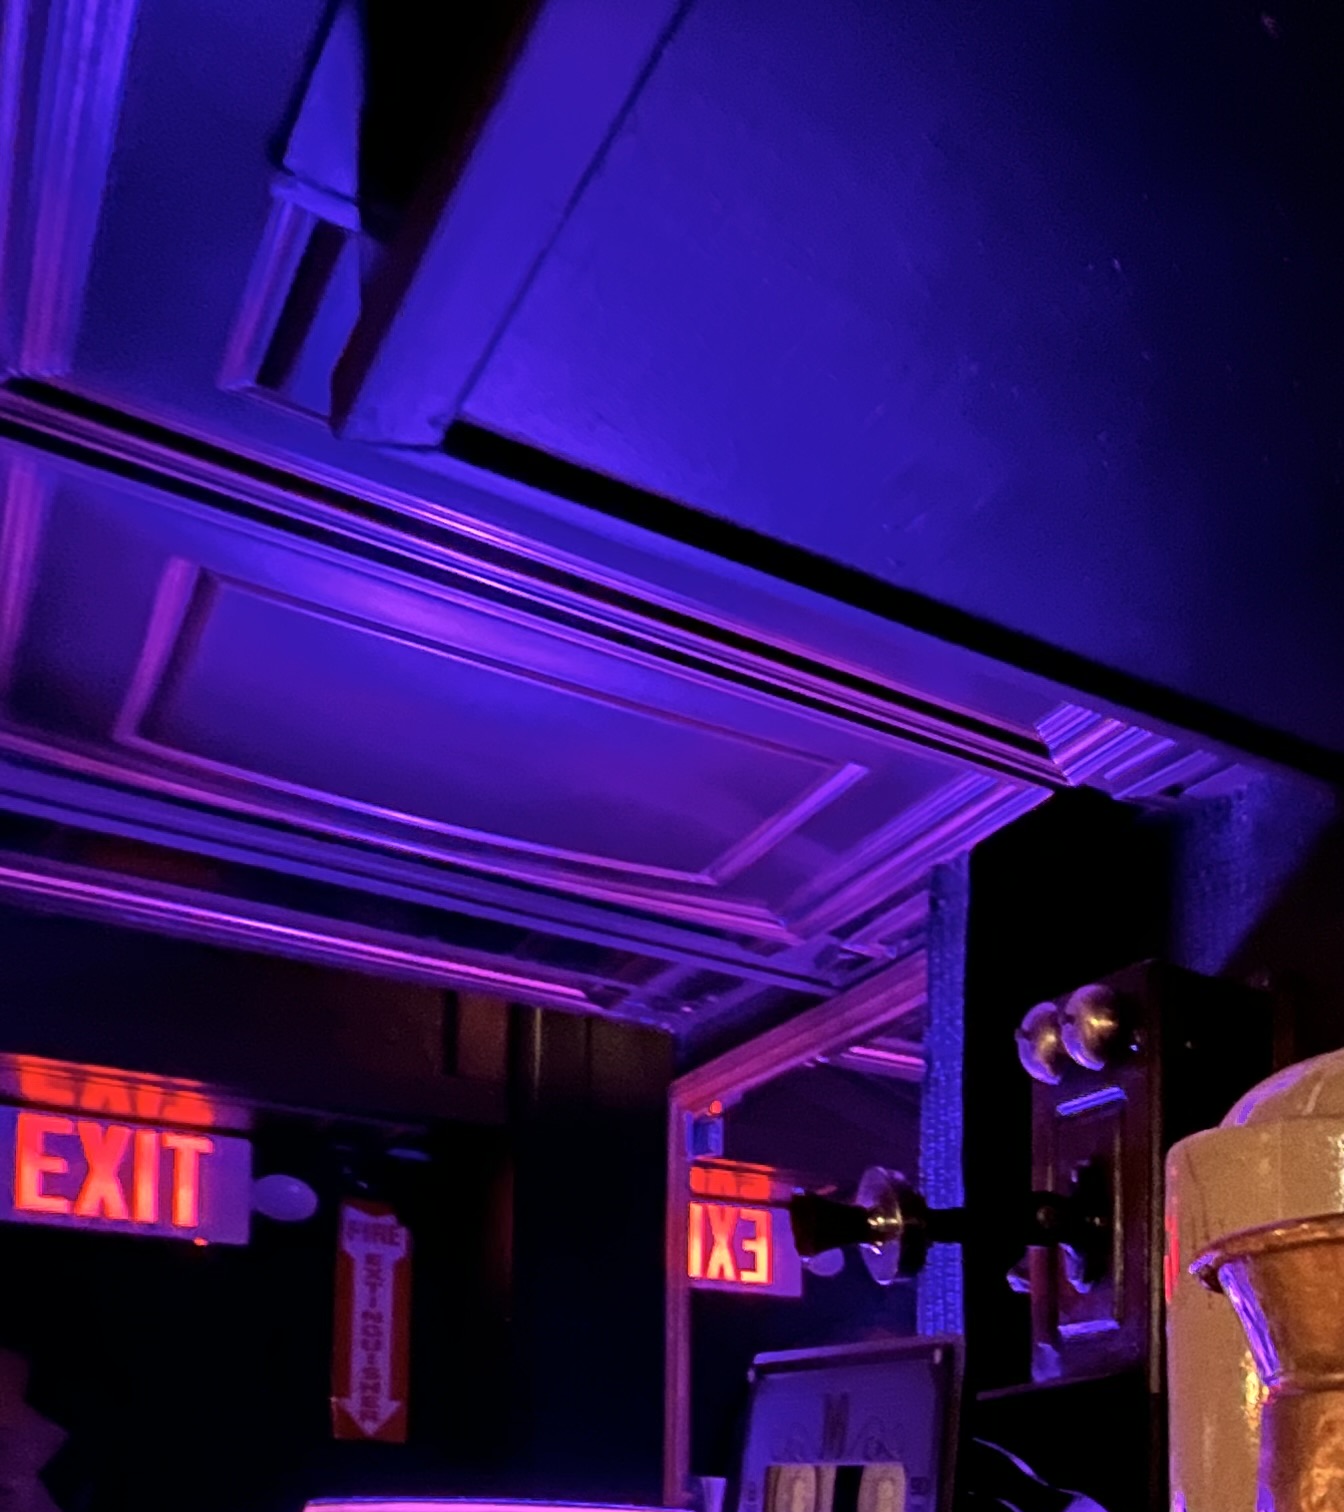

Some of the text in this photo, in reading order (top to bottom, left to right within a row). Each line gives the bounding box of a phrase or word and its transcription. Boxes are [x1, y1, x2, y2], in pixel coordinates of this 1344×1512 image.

[14, 1112, 215, 1229] EXIT
[347, 1219, 402, 1247] FIRE
[359, 1252, 386, 1423] EXTINGUISHER
